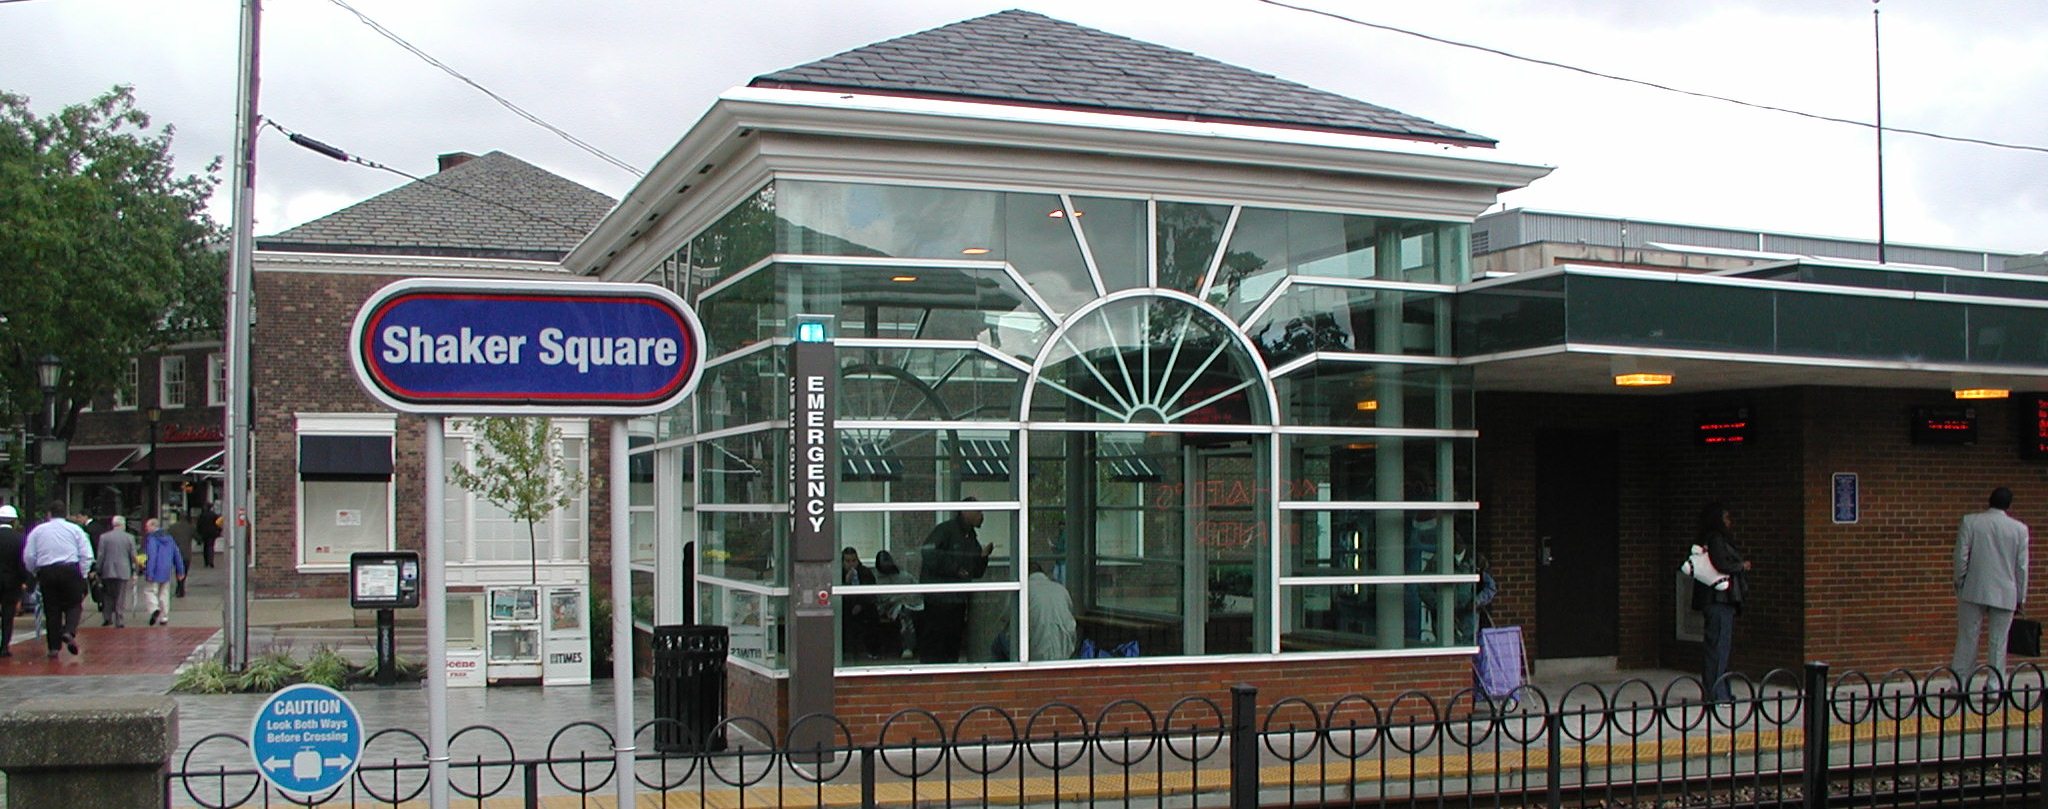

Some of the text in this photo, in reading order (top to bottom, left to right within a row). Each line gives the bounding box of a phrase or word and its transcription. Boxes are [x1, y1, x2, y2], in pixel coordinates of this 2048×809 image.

[382, 325, 678, 374] Shaker Square
[807, 376, 825, 533] EMERGENCY
[557, 652, 583, 664] TIMES
[274, 699, 341, 715] CAUTION
[266, 718, 348, 731] Look Both Ways
[267, 732, 348, 743] Before Crossing
